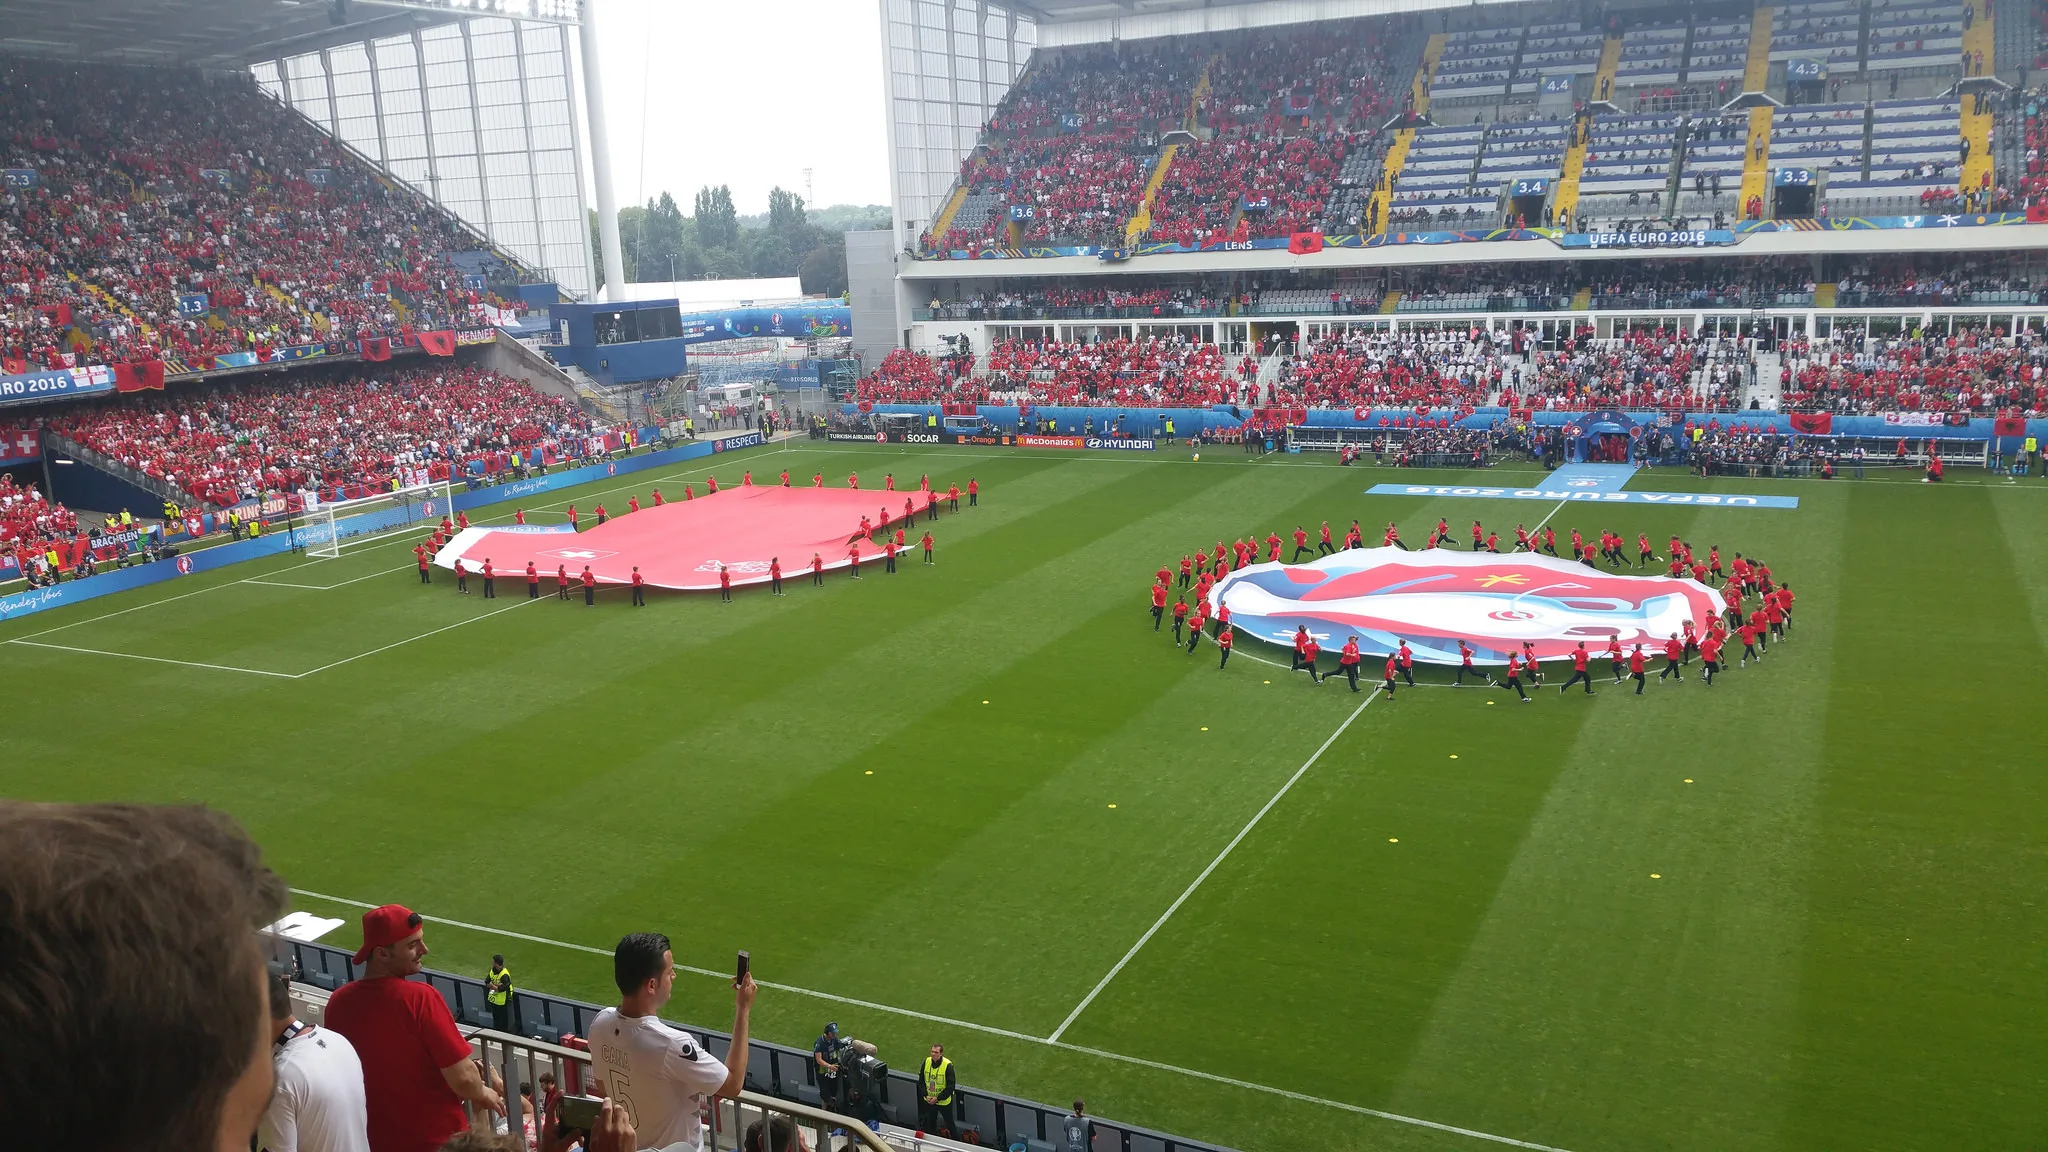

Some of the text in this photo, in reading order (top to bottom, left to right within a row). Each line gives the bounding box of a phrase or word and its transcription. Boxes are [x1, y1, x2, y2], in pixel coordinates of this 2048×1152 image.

[1795, 63, 1819, 75] 4.3
[1547, 79, 1569, 91] 4.4
[1067, 117, 1083, 127] 4.6
[7, 174, 30, 186] 2.3
[312, 174, 326, 184] 2.1
[1783, 170, 1809, 183] 3.3
[1519, 181, 1542, 193] 3.4
[1016, 207, 1034, 218] 3.6
[1590, 231, 1706, 245] UEFA EURO 2016
[1225, 240, 1253, 251] LENS
[469, 279, 483, 289] 1.1
[182, 301, 202, 313] 1.3
[0, 376, 68, 397] RO 2016
[725, 433, 759, 450] RESPECT
[829, 433, 852, 441] TURKISH
[907, 433, 939, 443] SOCAR
[971, 435, 997, 445] Orange
[1026, 437, 1074, 447] McDonald's
[1104, 439, 1153, 449] HYUNDAI
[1405, 486, 1758, 505] UEFA EURO 2016
[90, 530, 139, 549] BRACHELEN
[609, 1069, 640, 1130] 5
